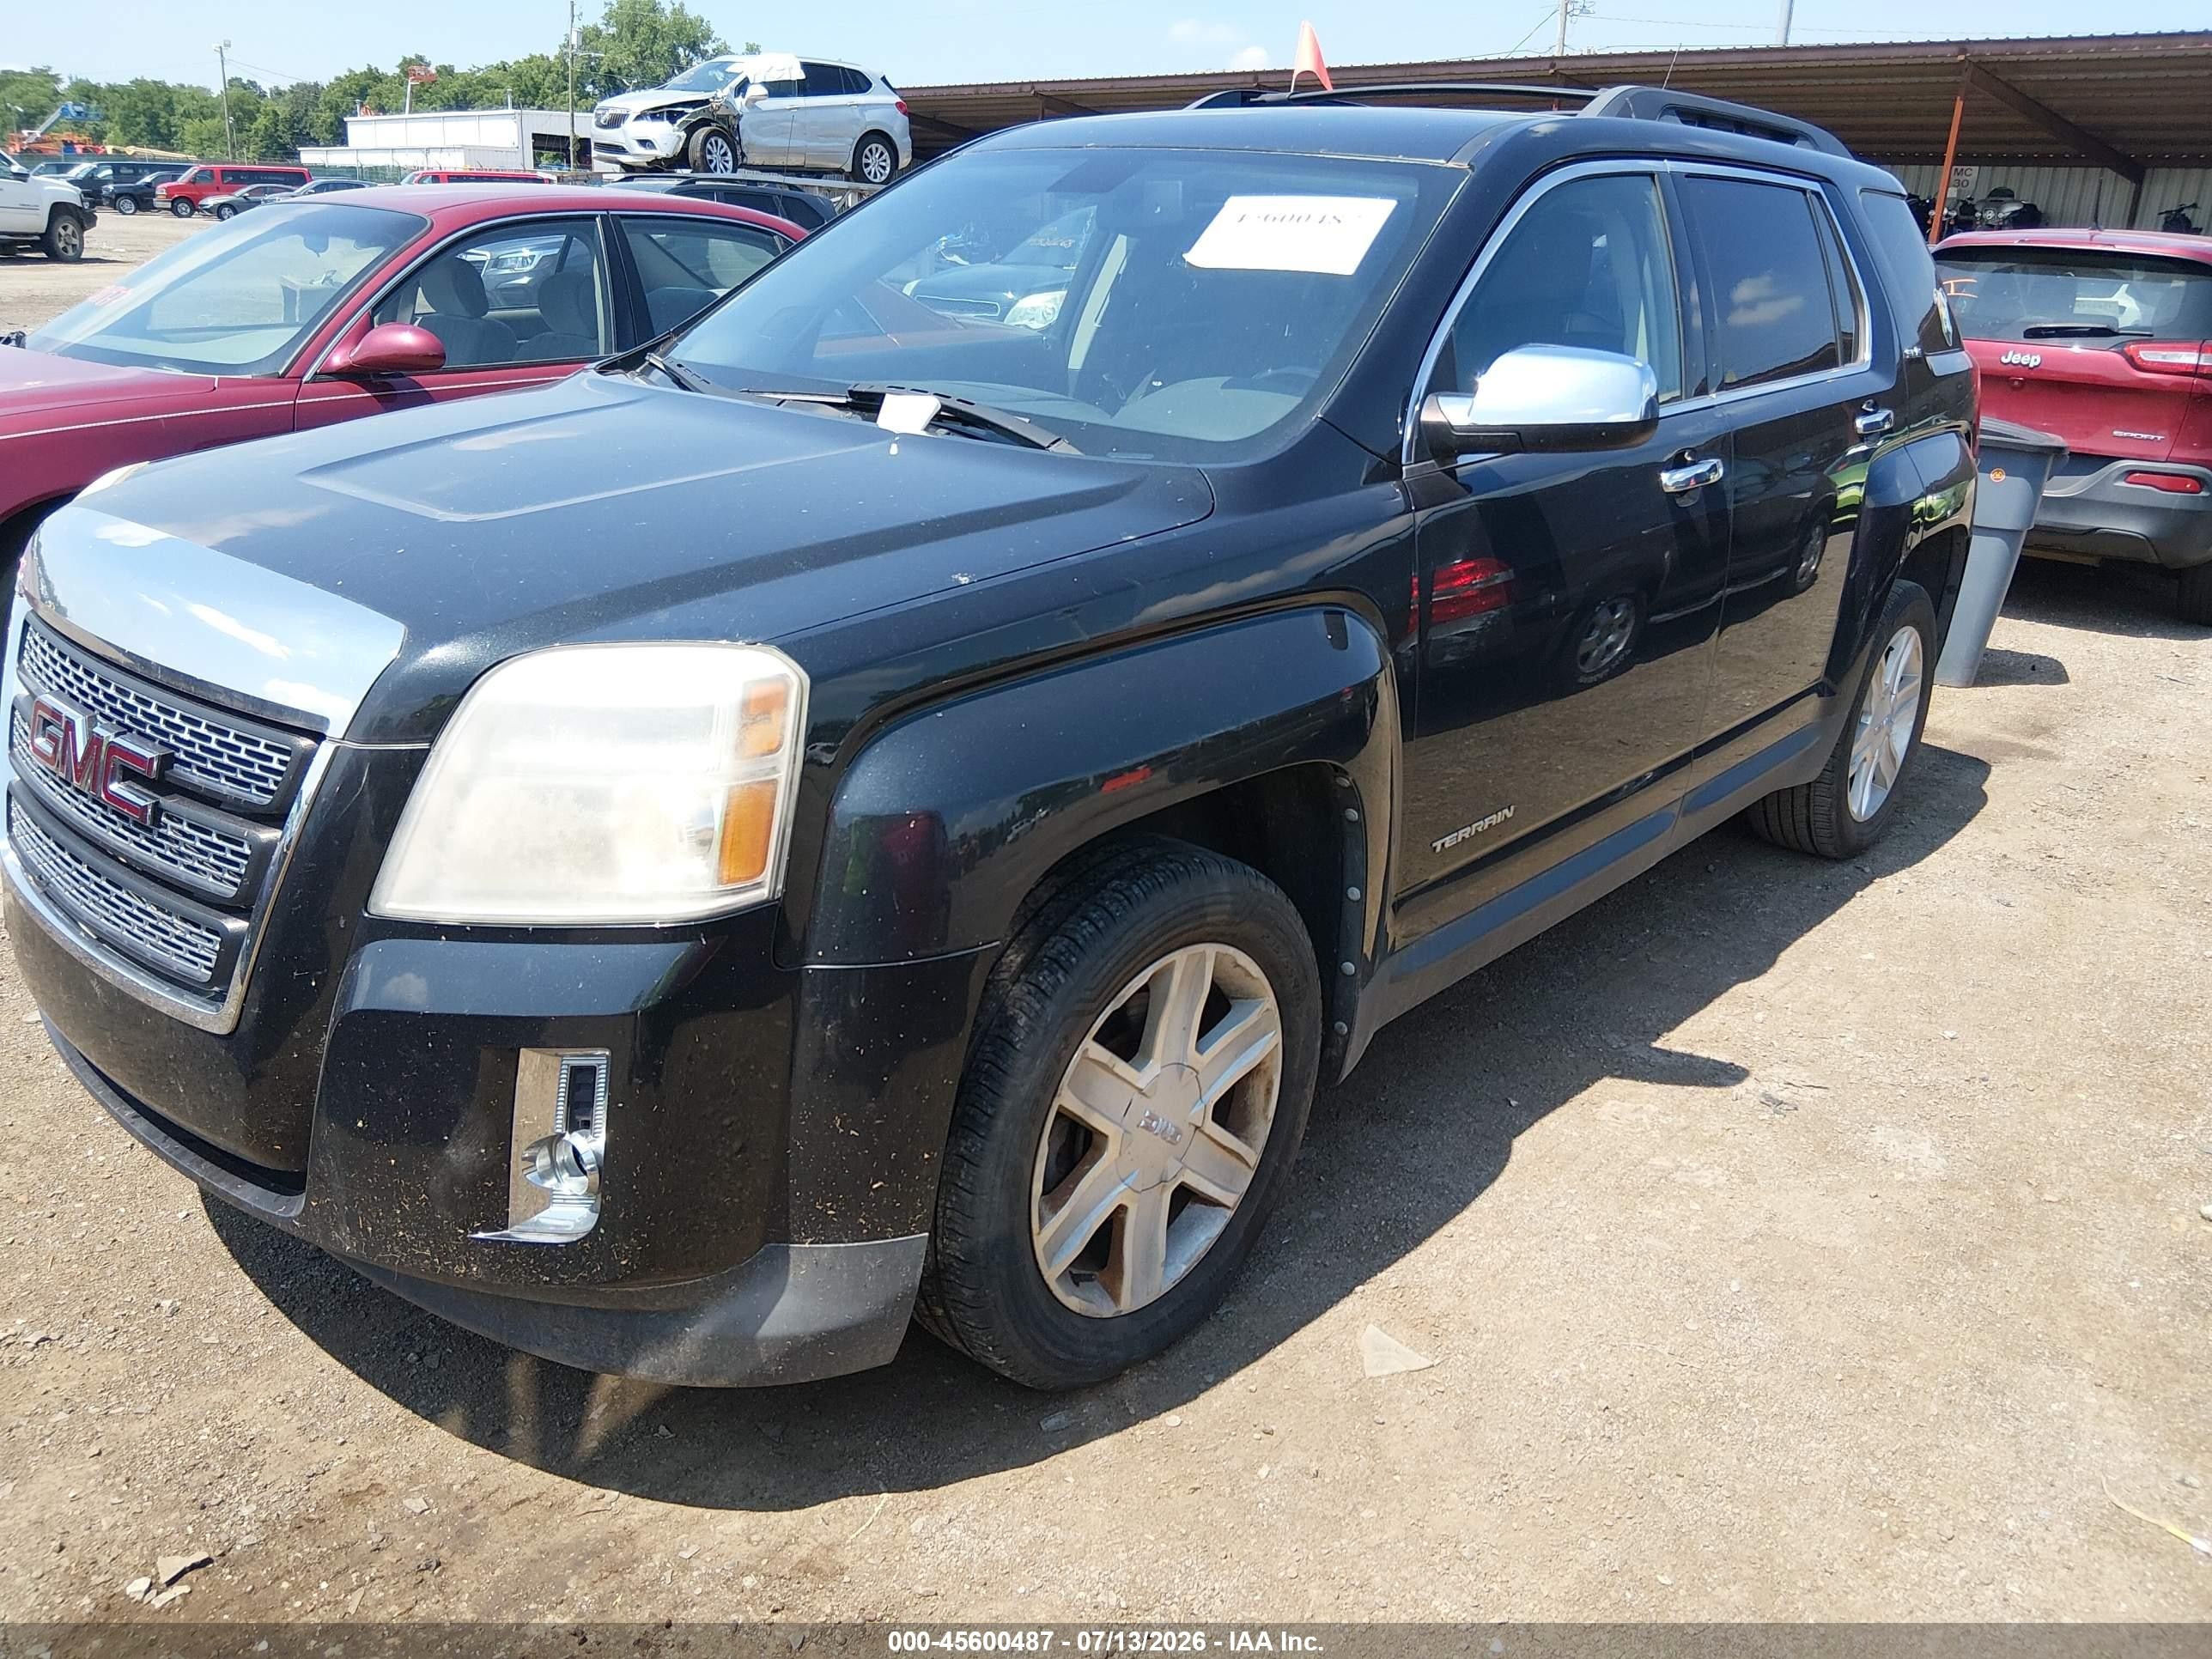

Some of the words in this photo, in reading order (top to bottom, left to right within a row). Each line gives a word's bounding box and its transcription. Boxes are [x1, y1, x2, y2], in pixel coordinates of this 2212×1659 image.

[1954, 167, 1972, 177] MC
[1953, 179, 1970, 188] 30
[2001, 350, 2041, 368] Jeep
[2112, 430, 2166, 441] SPORT
[30, 691, 172, 826] GMC
[1431, 805, 1516, 853] TERRAIN
